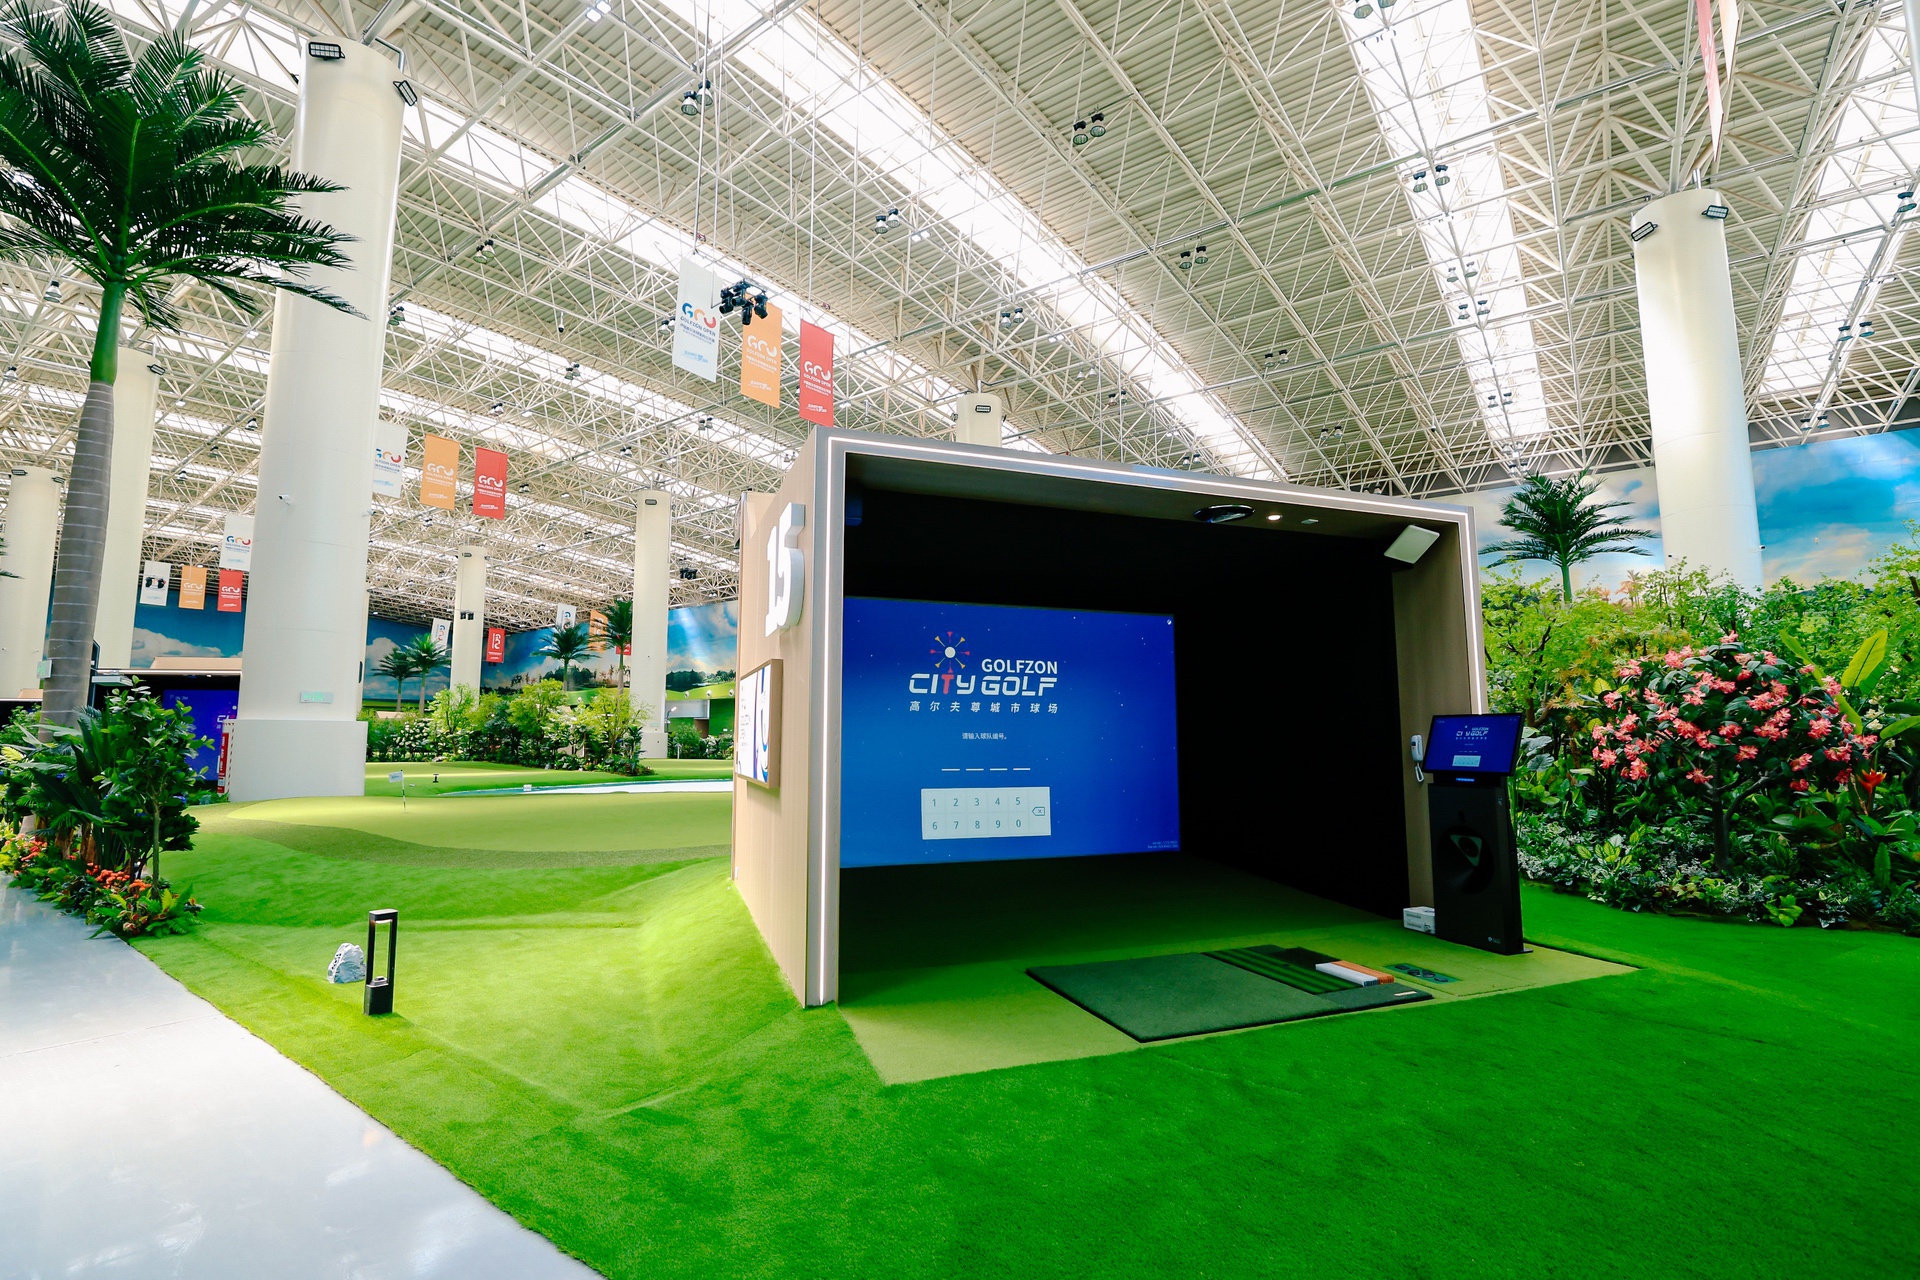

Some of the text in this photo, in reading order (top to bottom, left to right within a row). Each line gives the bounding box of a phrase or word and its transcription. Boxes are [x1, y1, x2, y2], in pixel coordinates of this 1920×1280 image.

[680, 316, 703, 331] GOLFZON
[702, 327, 716, 337] OPEN
[765, 502, 803, 638] 15
[981, 658, 1058, 675] GOLFZON
[908, 673, 1058, 697] CITY GOLF
[909, 700, 1058, 714] 高尔夫尊城市球场
[932, 797, 1020, 807] 1 2 3 4 5
[932, 819, 1021, 830] 6 7 8 9 0
